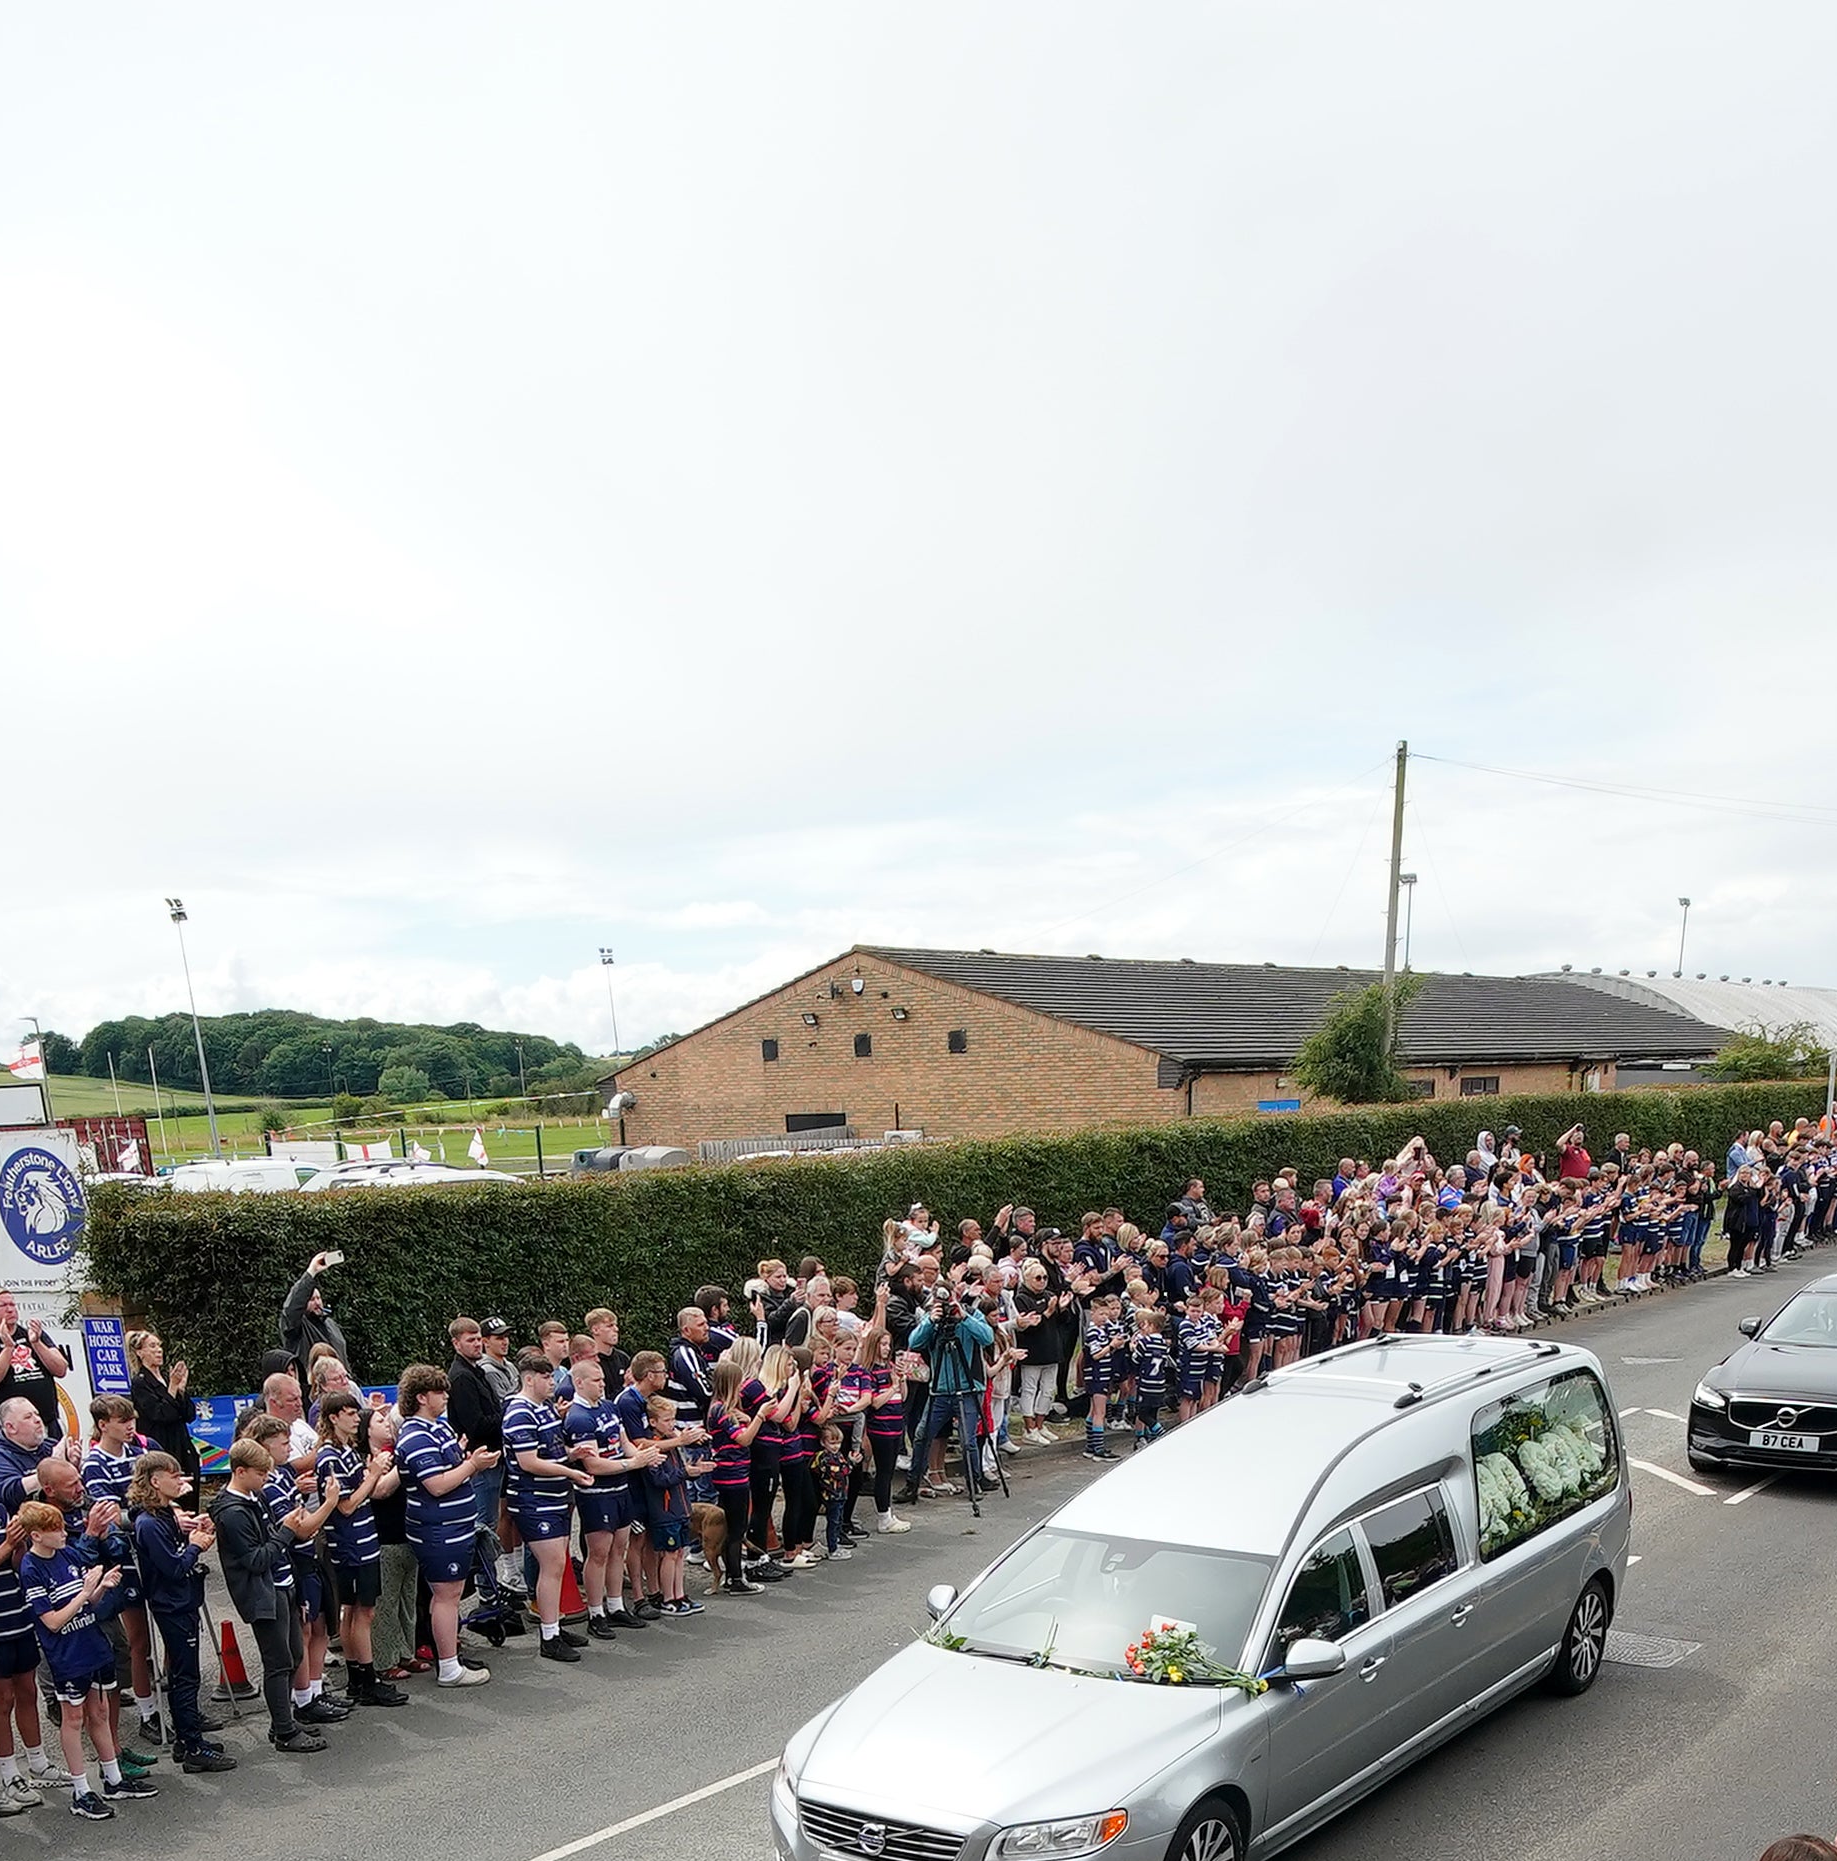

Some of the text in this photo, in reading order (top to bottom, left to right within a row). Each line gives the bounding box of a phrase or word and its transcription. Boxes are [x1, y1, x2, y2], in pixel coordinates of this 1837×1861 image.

[91, 1320, 115, 1333] WAR
[88, 1334, 123, 1348] HORSE
[96, 1349, 119, 1362] CAR
[96, 1363, 124, 1377] PARK
[1762, 1434, 1804, 1449] B7 CEA
